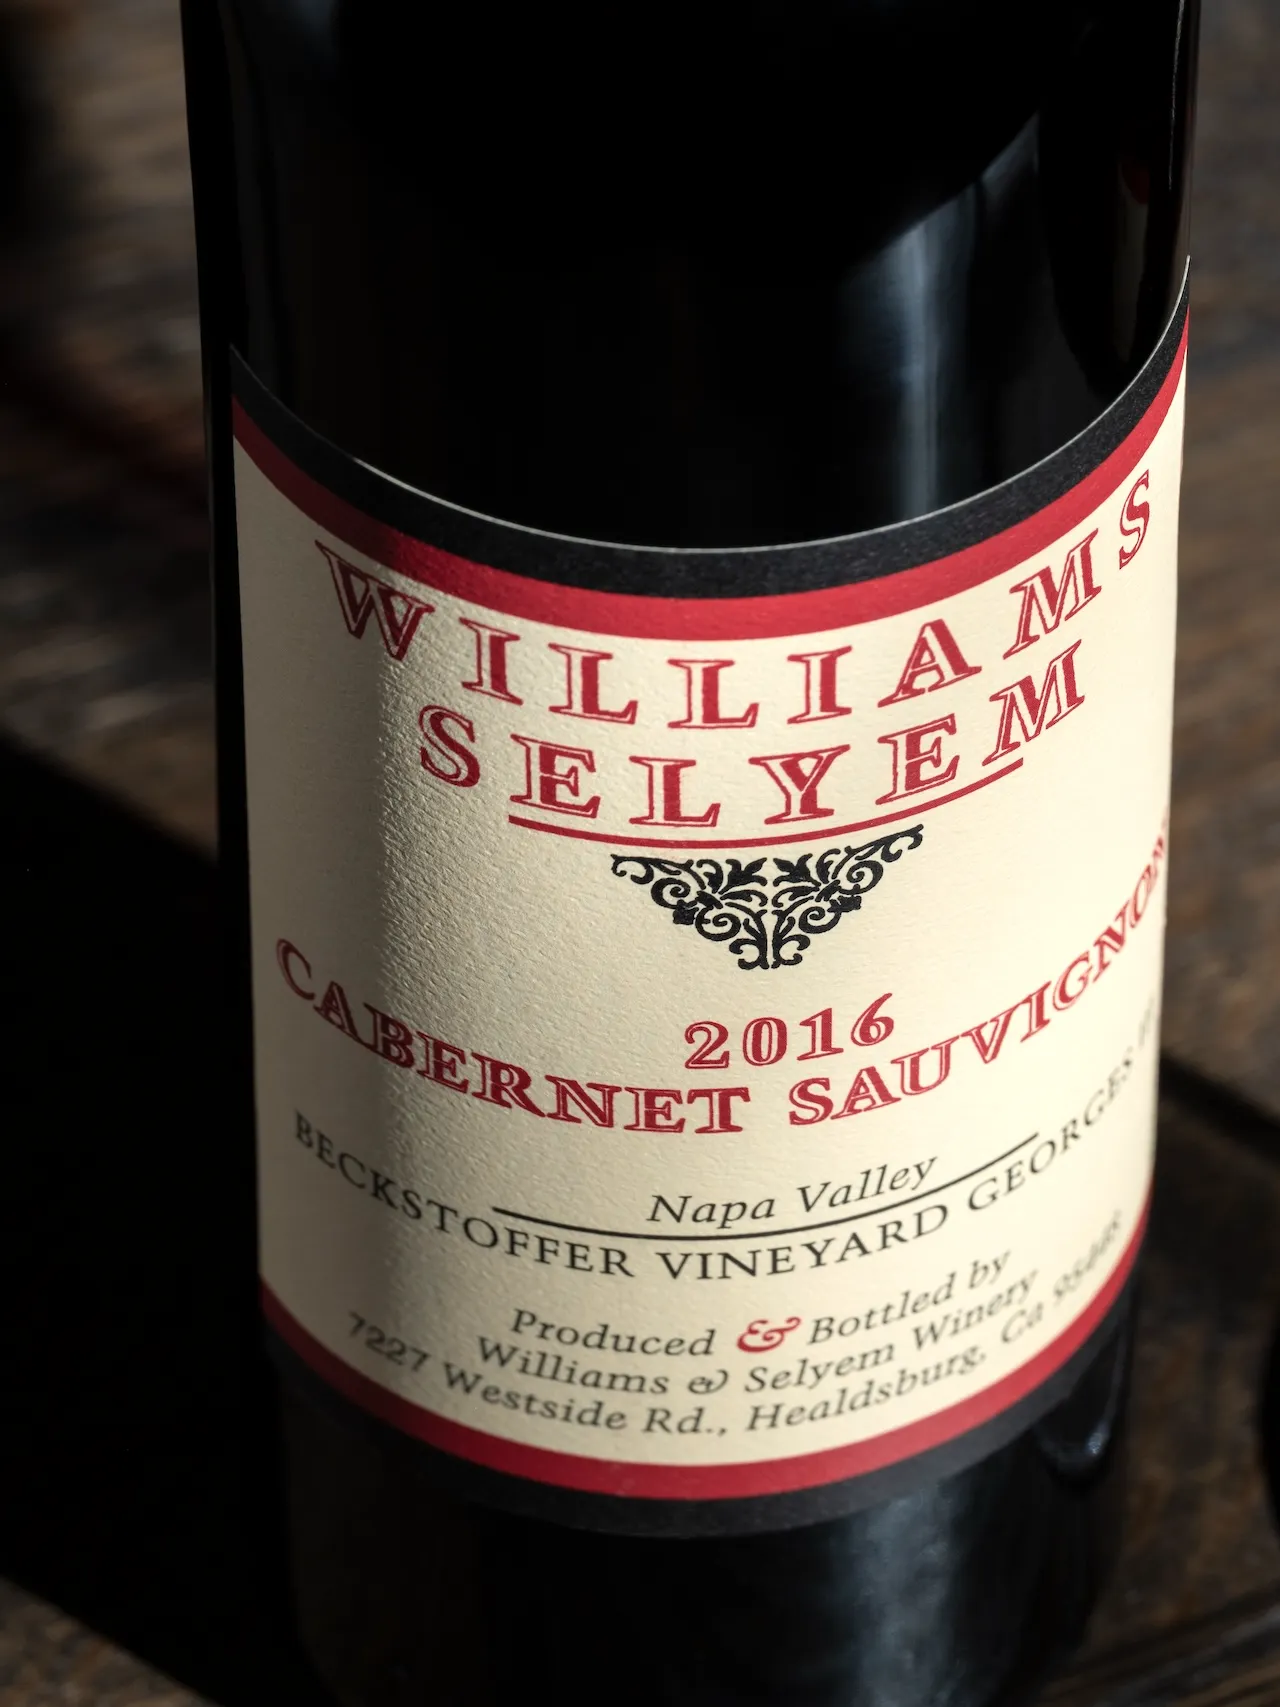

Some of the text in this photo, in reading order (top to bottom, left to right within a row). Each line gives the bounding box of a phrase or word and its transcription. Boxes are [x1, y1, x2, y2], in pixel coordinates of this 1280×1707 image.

[314, 469, 1153, 729] WILLIAMS
[419, 640, 1086, 828] SELYEM
[275, 937, 752, 1134] CABERNET
[683, 992, 895, 1070] 2016
[293, 1045, 1134, 1281] BECKSTOFFER VINEYARD GEORGES
[647, 1154, 938, 1230] Napa Valley
[476, 1335, 670, 1395] Williams
[744, 1342, 895, 1393] Selyem
[911, 1269, 1040, 1352] Winery
[512, 1250, 1012, 1357] Produced & Bottled by
[347, 1311, 431, 1373] 7227
[443, 1362, 628, 1432] Westside
[640, 1406, 728, 1437] Rd.,
